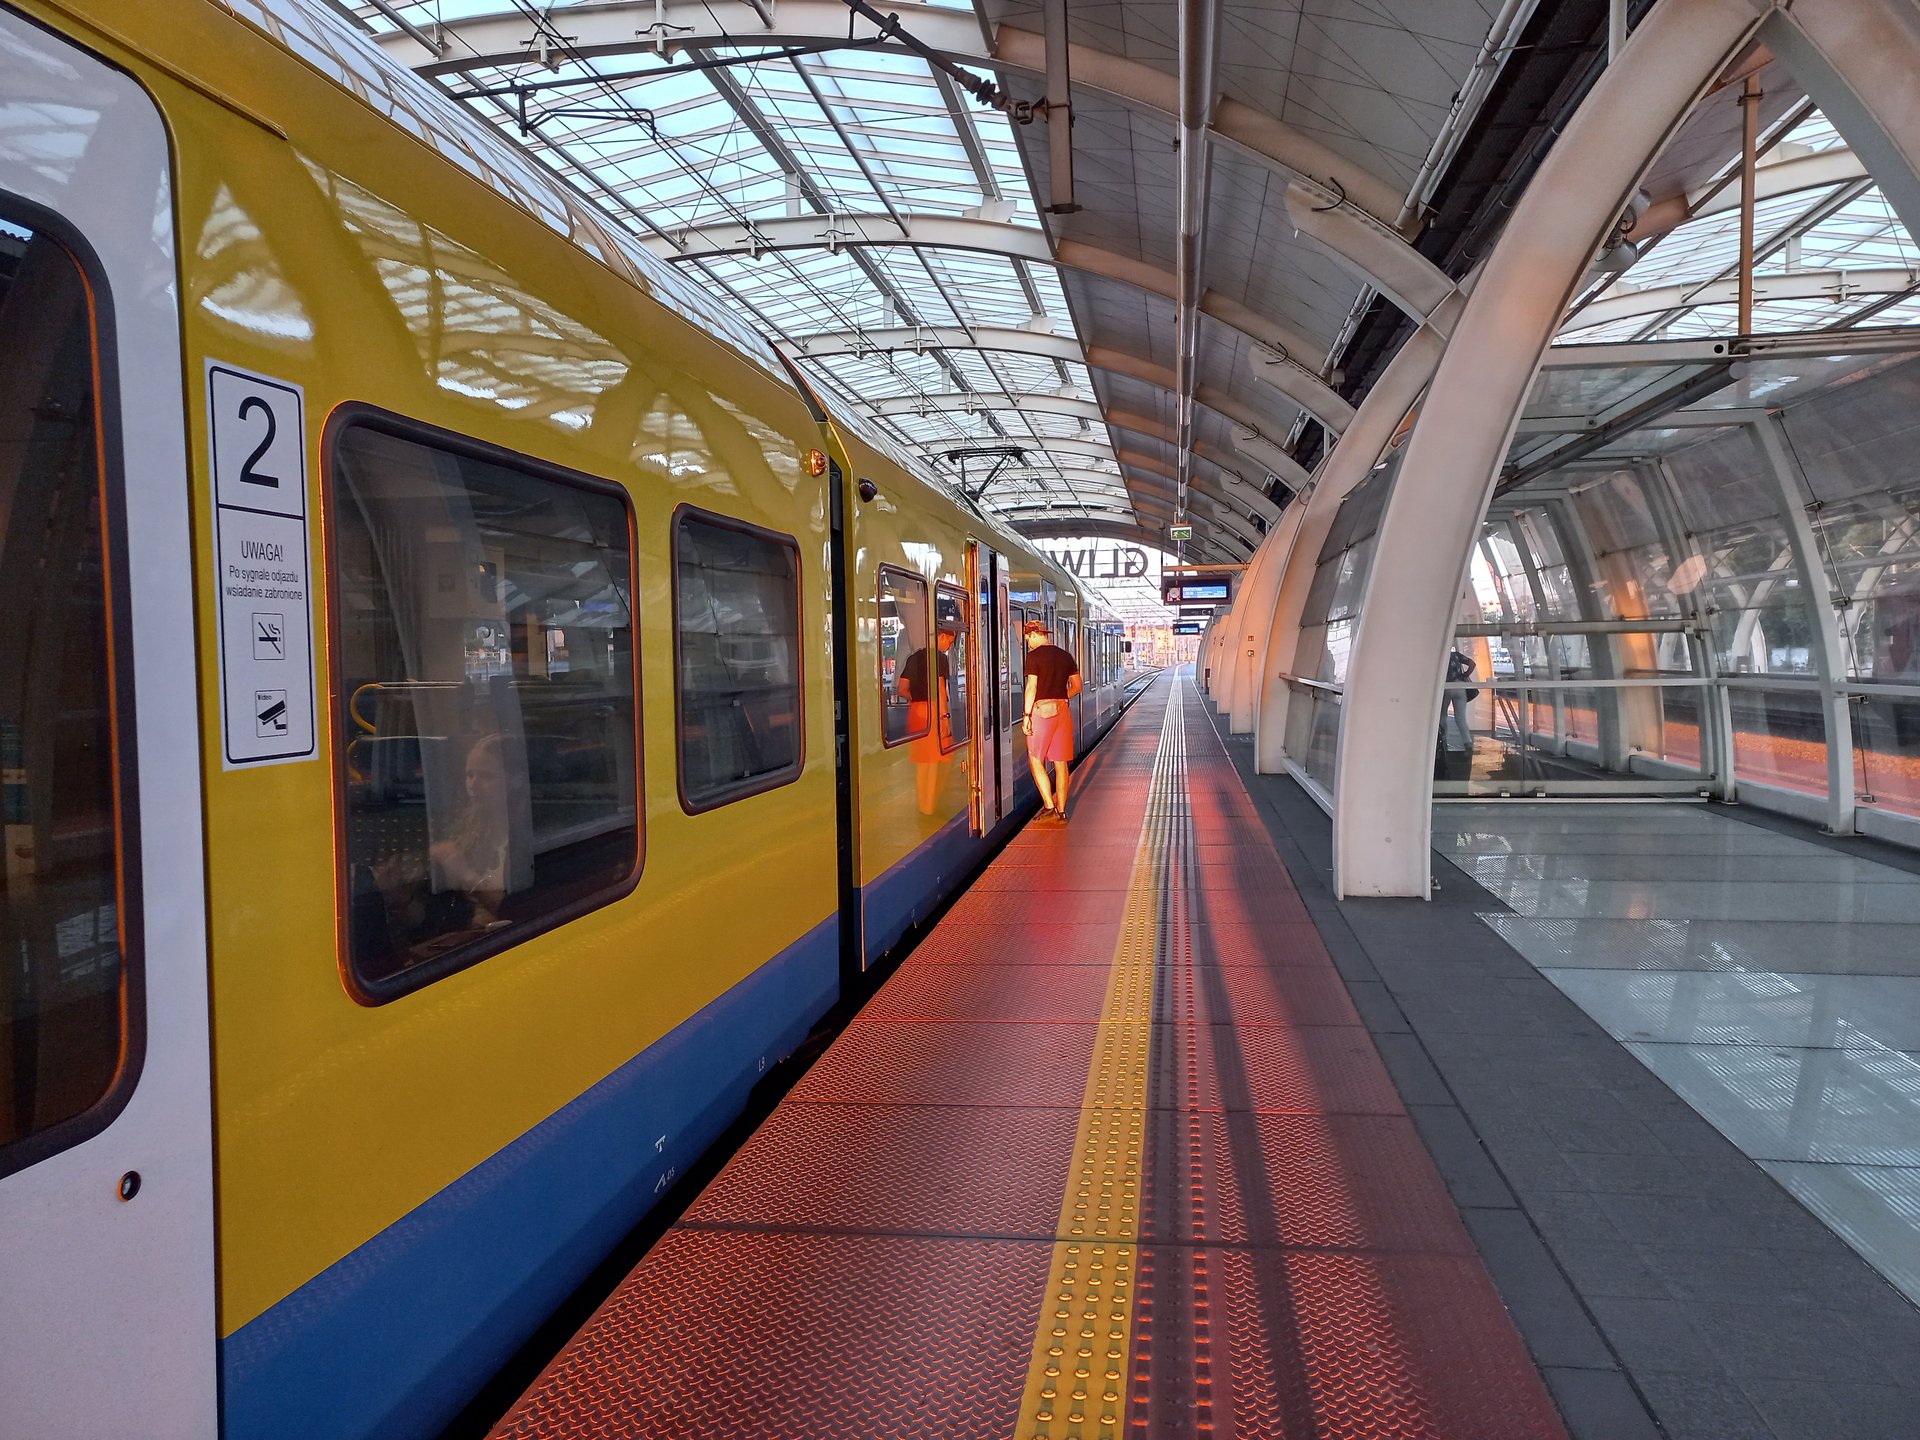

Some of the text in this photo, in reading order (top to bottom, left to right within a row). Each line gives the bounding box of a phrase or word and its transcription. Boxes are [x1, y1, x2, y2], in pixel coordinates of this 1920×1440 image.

[238, 396, 279, 488] 2
[241, 540, 283, 562] UWAGA!
[229, 565, 298, 584] Po sygnale odjazdu
[226, 585, 302, 600] wsiadanie zabronione
